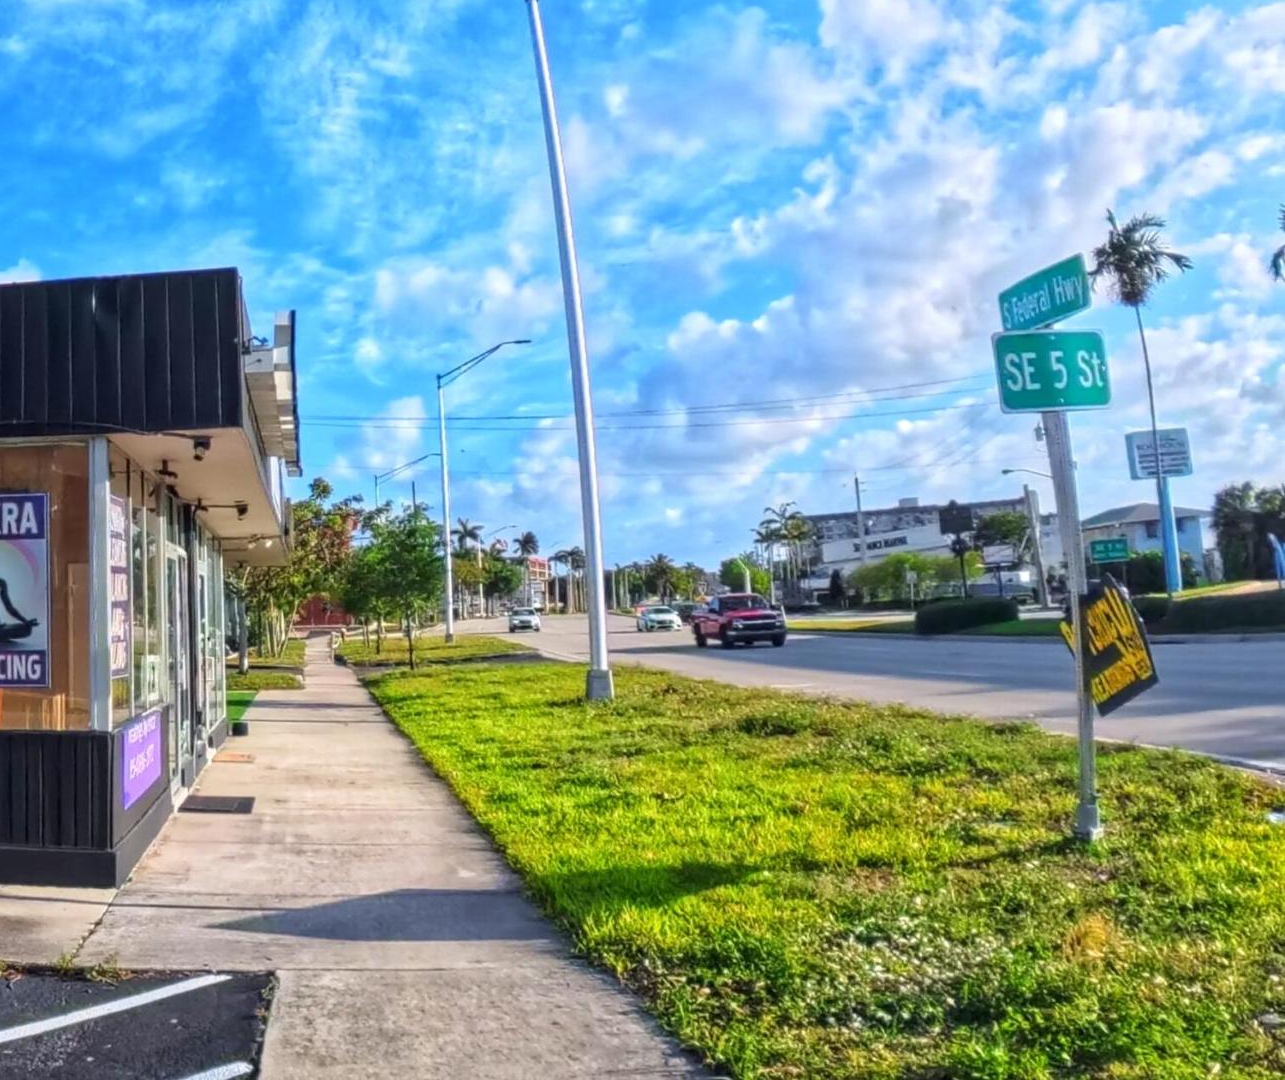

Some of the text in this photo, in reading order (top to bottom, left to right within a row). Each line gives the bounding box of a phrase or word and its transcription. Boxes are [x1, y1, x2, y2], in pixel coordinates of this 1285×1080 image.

[1003, 273, 1084, 329] S Federal Hwy
[1004, 349, 1104, 392] SE 5 St
